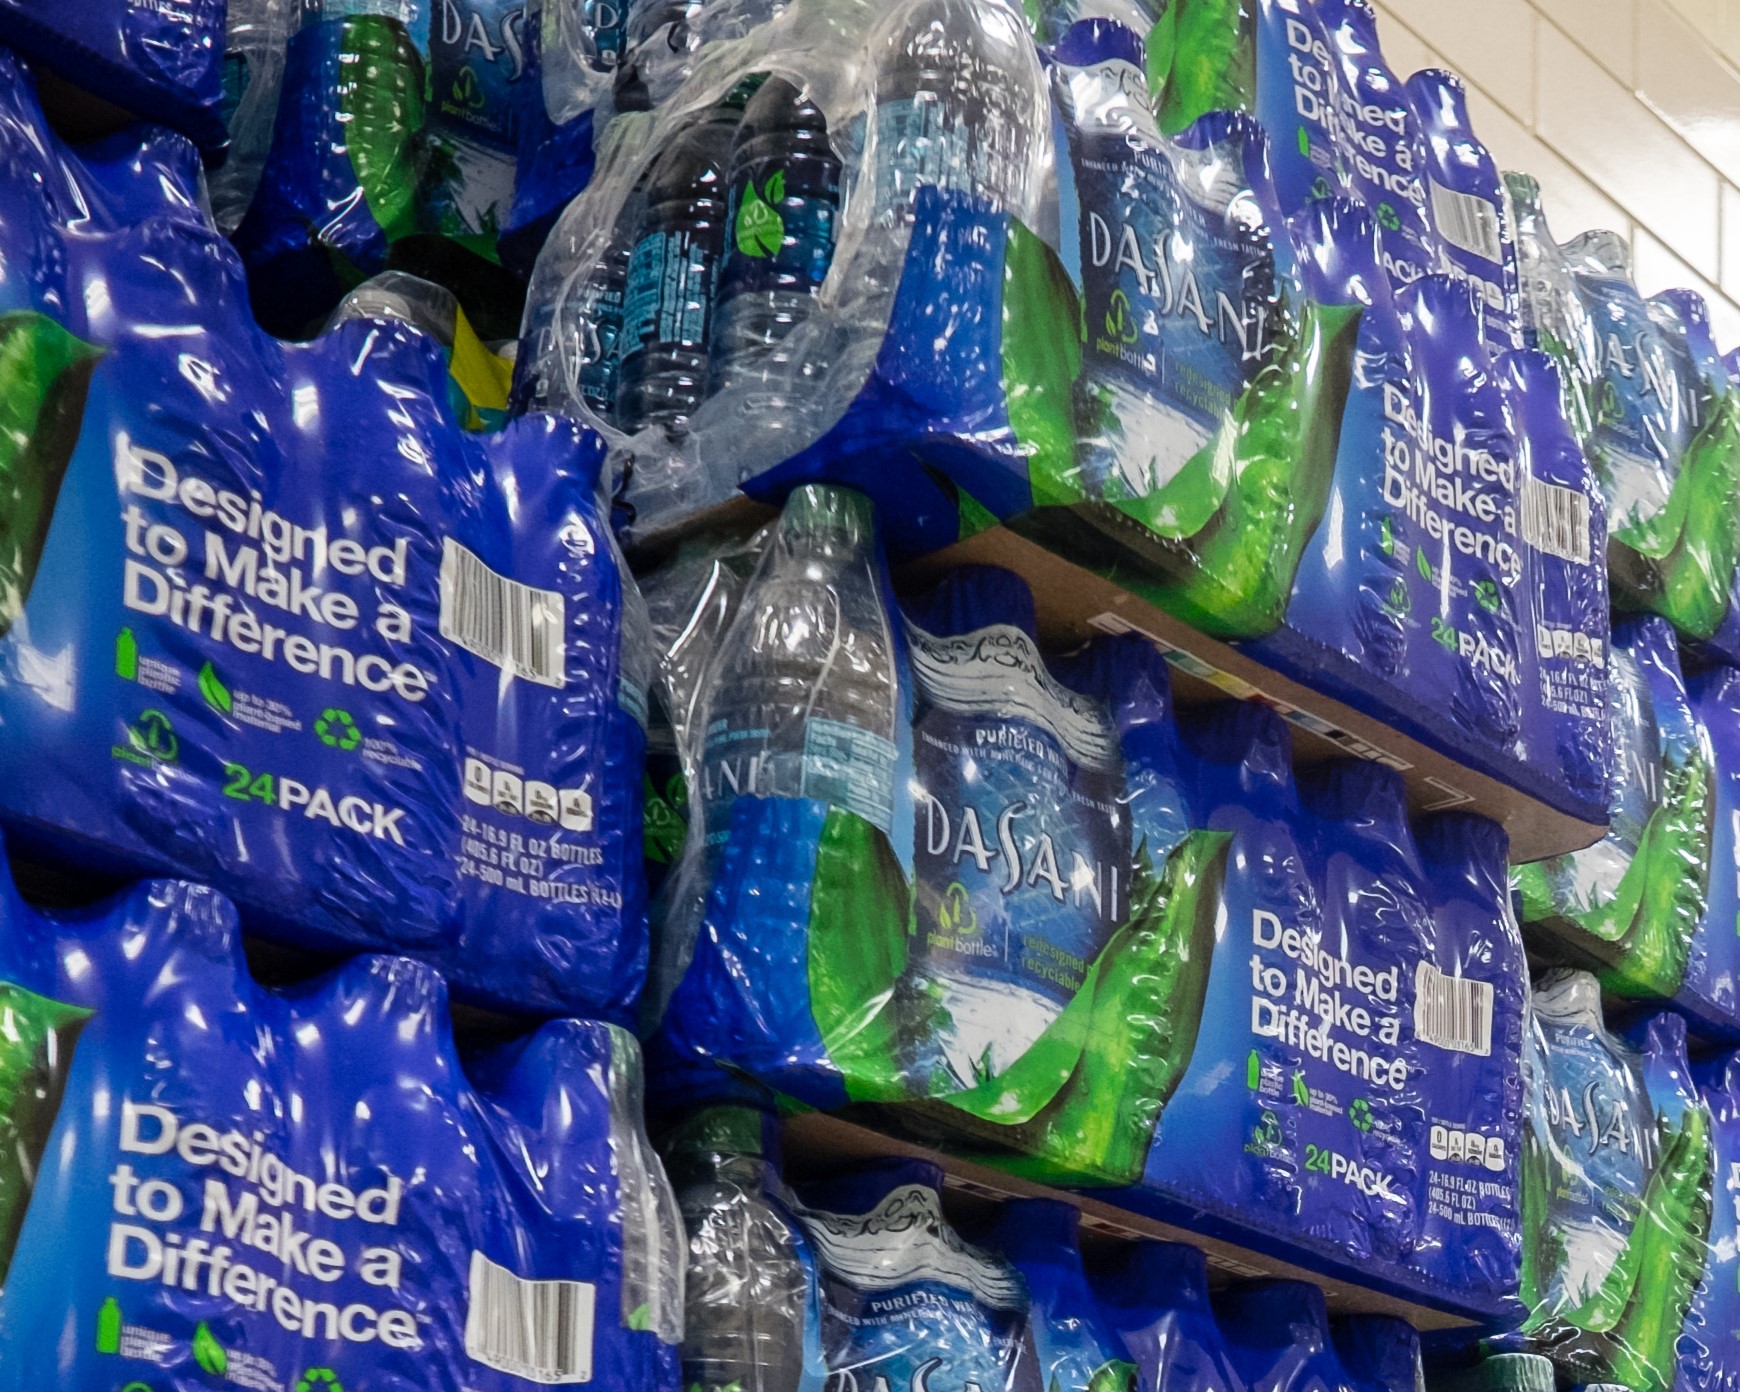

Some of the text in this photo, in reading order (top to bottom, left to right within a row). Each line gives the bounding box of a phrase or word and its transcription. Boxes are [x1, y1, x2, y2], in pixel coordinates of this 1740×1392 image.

[1089, 211, 1265, 361] DASANI
[128, 446, 408, 586] Designed
[1382, 424, 1516, 537] to Make a
[1384, 462, 1523, 580] Difference
[121, 503, 412, 645] to Make a
[123, 558, 428, 701] Difference
[1430, 617, 1521, 685] 24PACK
[223, 762, 406, 846] 24PACK
[927, 794, 1117, 922] DASANI
[1249, 954, 1400, 1046] to Make a
[1252, 908, 1398, 1002] Designed
[1251, 996, 1407, 1090] Difference
[119, 1102, 401, 1226] Designed
[1304, 1143, 1404, 1204] 24PACK
[1544, 1081, 1653, 1170] DASANI
[107, 1223, 418, 1349] Difference
[109, 1164, 401, 1290] to Make a
